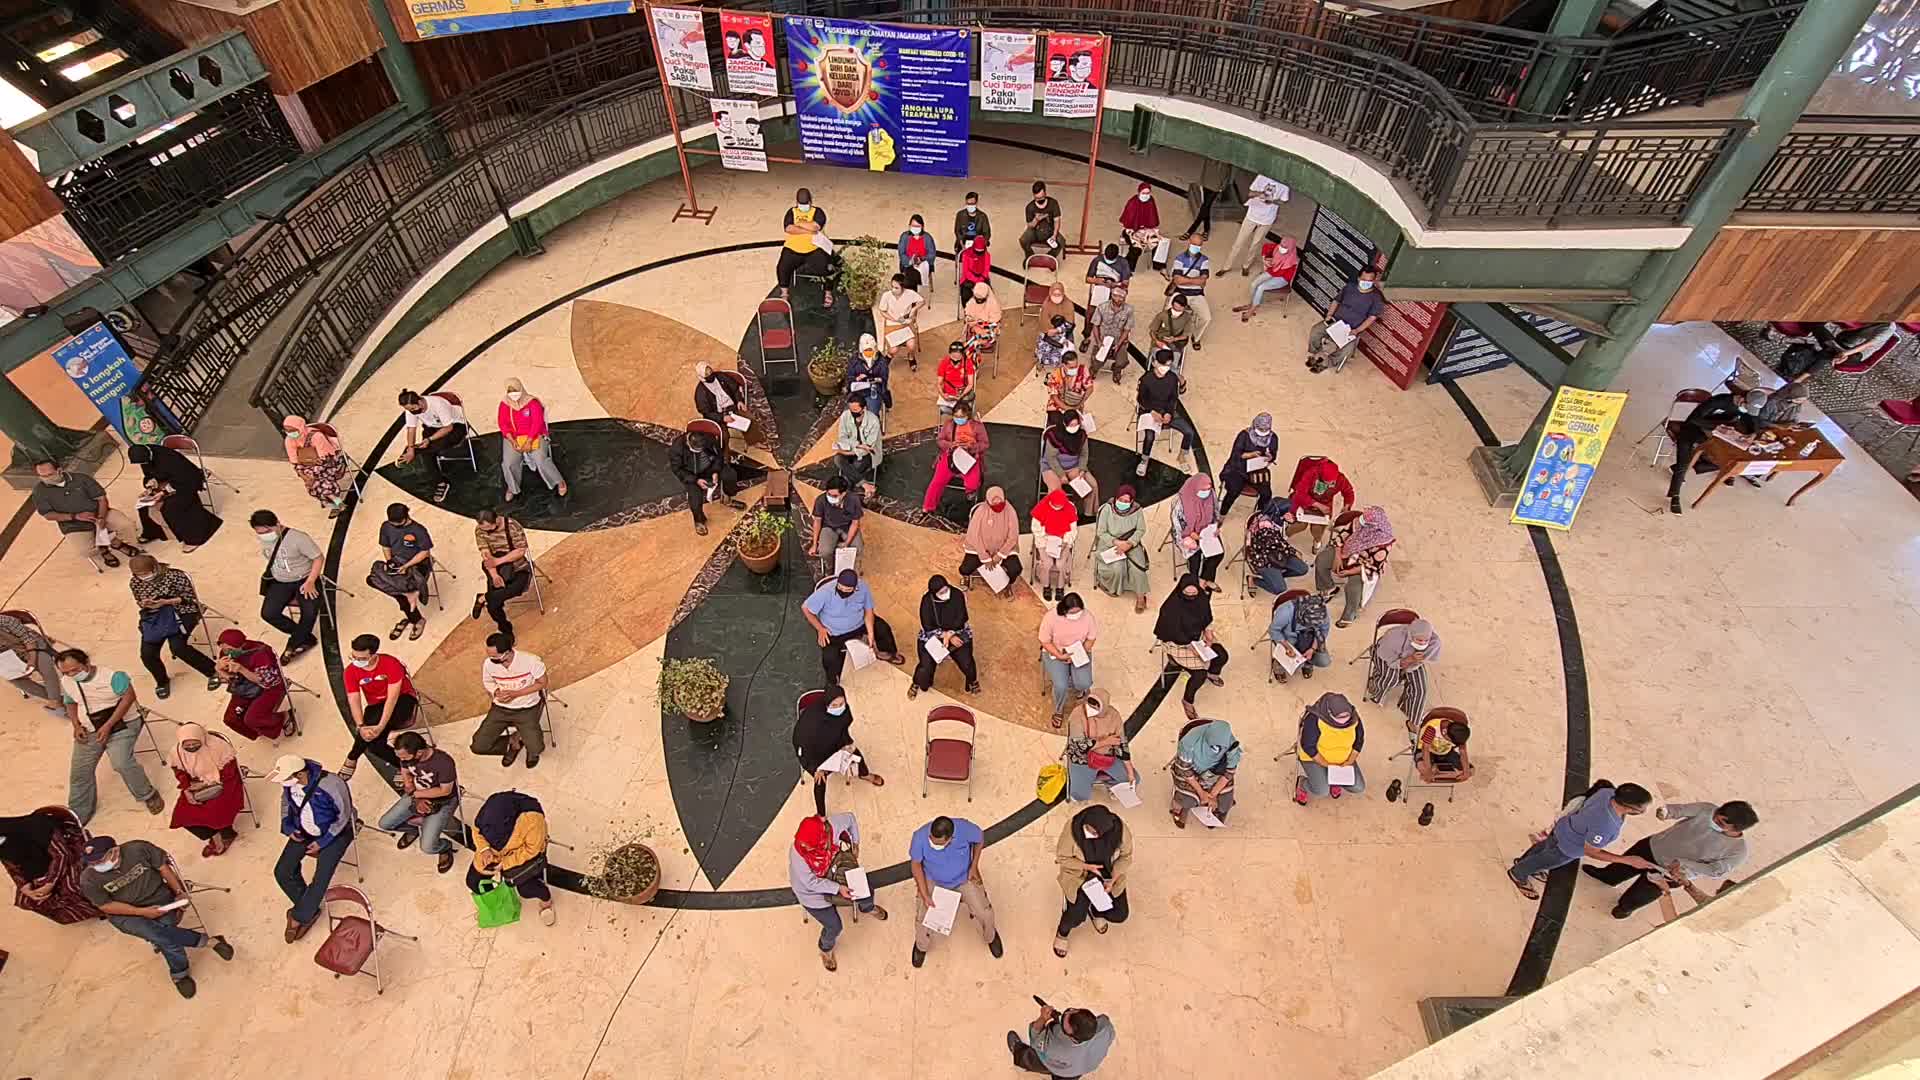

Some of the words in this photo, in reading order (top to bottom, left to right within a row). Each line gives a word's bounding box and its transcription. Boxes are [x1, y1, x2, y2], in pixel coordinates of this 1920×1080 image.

[411, 0, 466, 15] GERMAS
[824, 27, 859, 37] PUSKESMAS
[860, 30, 895, 39] KECAMATAN
[896, 32, 931, 41] JAGAKARSA
[669, 49, 694, 61] Sering
[664, 57, 680, 66] Cuci
[682, 59, 709, 70] Tangan
[828, 56, 857, 65] LINDUNGI
[673, 66, 697, 76] Pakai
[830, 64, 844, 72] DIRI
[844, 65, 857, 73] DAN
[670, 73, 698, 83] SABUN
[829, 73, 860, 82] KELUARGA
[991, 72, 1017, 83] Sering
[837, 81, 852, 89] DARI
[983, 80, 1000, 89] Cuci
[1002, 82, 1032, 91] Tangan
[991, 89, 1015, 98] Pakai
[985, 96, 1017, 106] SABUN
[901, 104, 933, 113] JANGAN
[934, 106, 955, 114] LUPA
[901, 111, 940, 120] TERAPKAN
[88, 356, 126, 384] langkah
[89, 370, 124, 397] mencuci
[95, 381, 127, 406] tangan
[1568, 420, 1599, 433] GERMAS
[1592, 834, 1603, 844] 9
